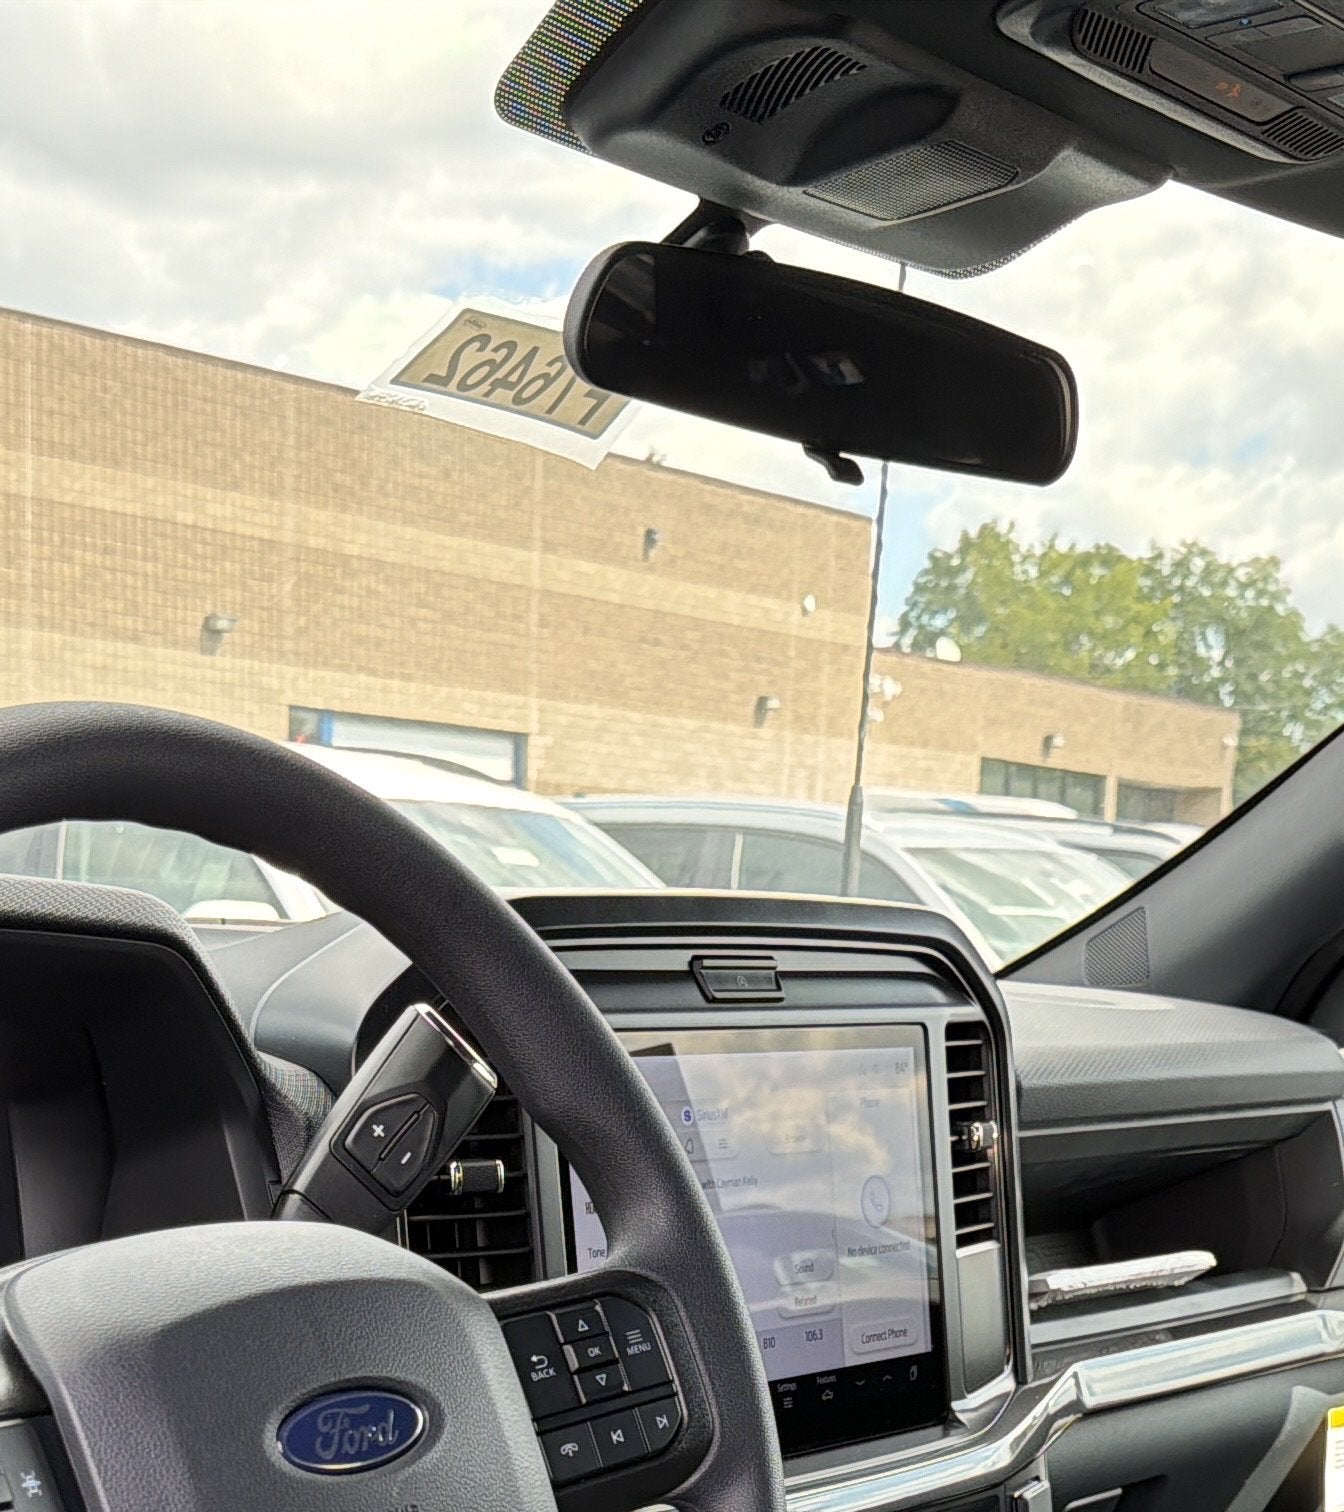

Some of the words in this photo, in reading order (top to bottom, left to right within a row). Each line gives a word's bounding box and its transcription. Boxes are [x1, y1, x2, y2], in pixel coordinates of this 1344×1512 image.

[587, 1246, 606, 1259] Tone
[794, 1261, 814, 1274] Sound
[763, 1337, 776, 1349] 810
[805, 1328, 824, 1342] 106.3
[861, 1331, 887, 1345] Connect
[888, 1327, 908, 1340] Phone
[587, 1346, 602, 1358] OK
[626, 1342, 652, 1357] MENU
[530, 1367, 557, 1382] BACK
[315, 1403, 400, 1461] Ford
